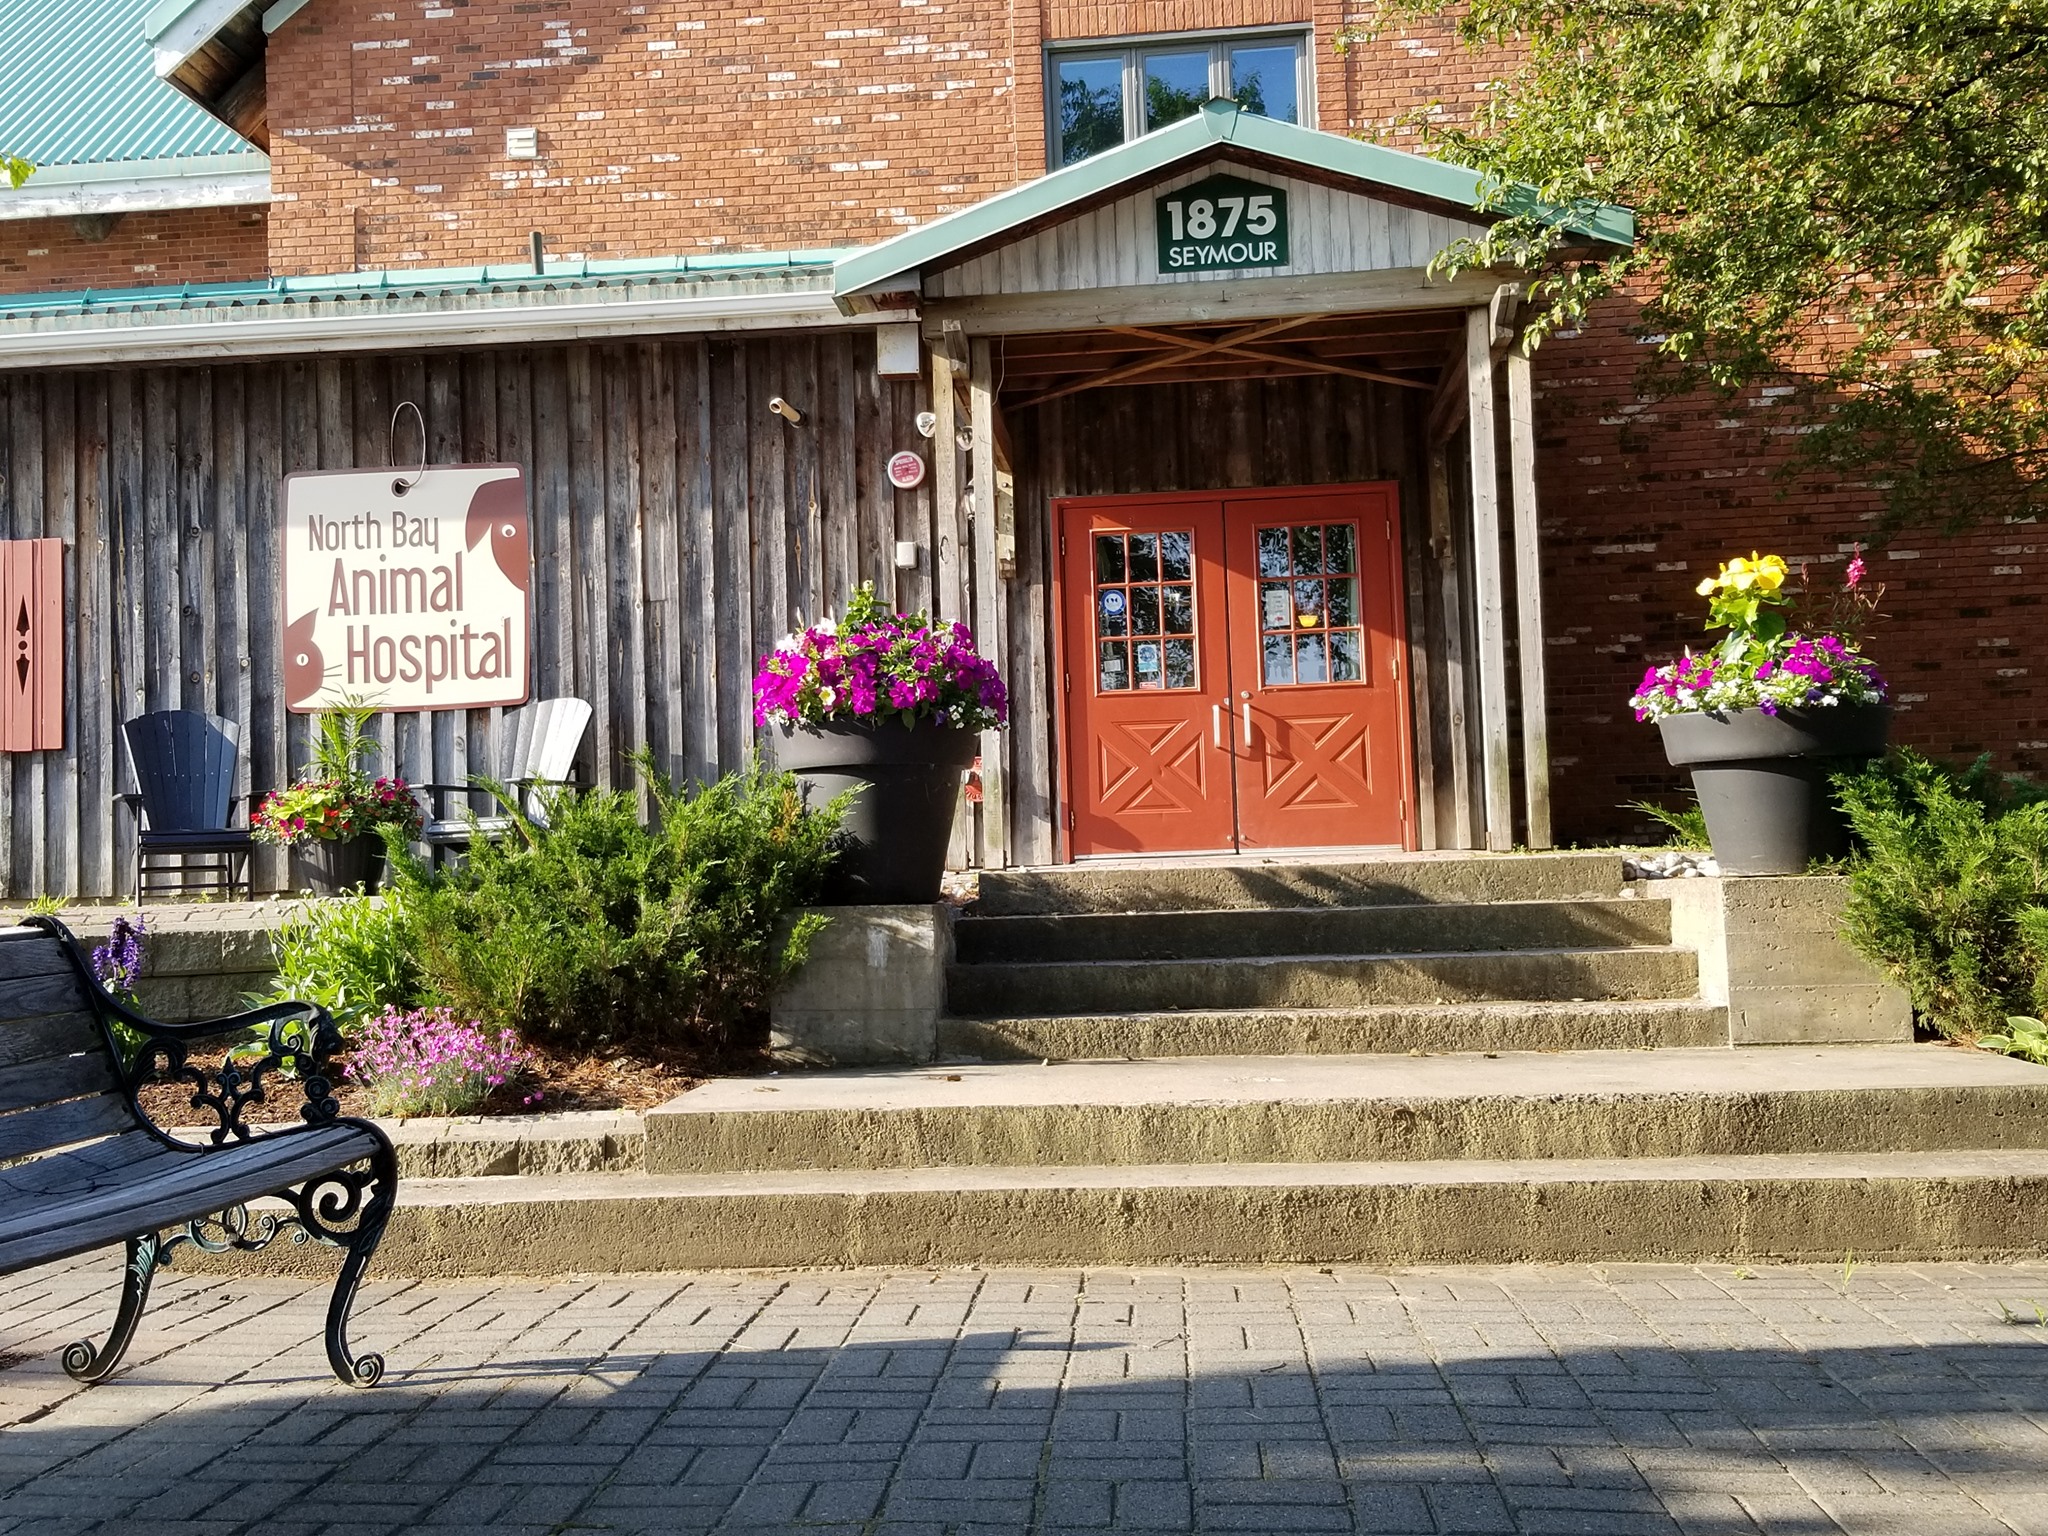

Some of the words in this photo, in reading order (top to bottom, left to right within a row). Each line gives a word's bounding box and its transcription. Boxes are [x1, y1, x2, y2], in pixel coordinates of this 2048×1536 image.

[1166, 195, 1277, 241] 1875
[1168, 241, 1278, 267] SEYMOUR
[308, 511, 382, 552] North
[392, 510, 439, 554] Bay
[327, 550, 464, 617] Animal
[346, 616, 512, 694] Hospital
